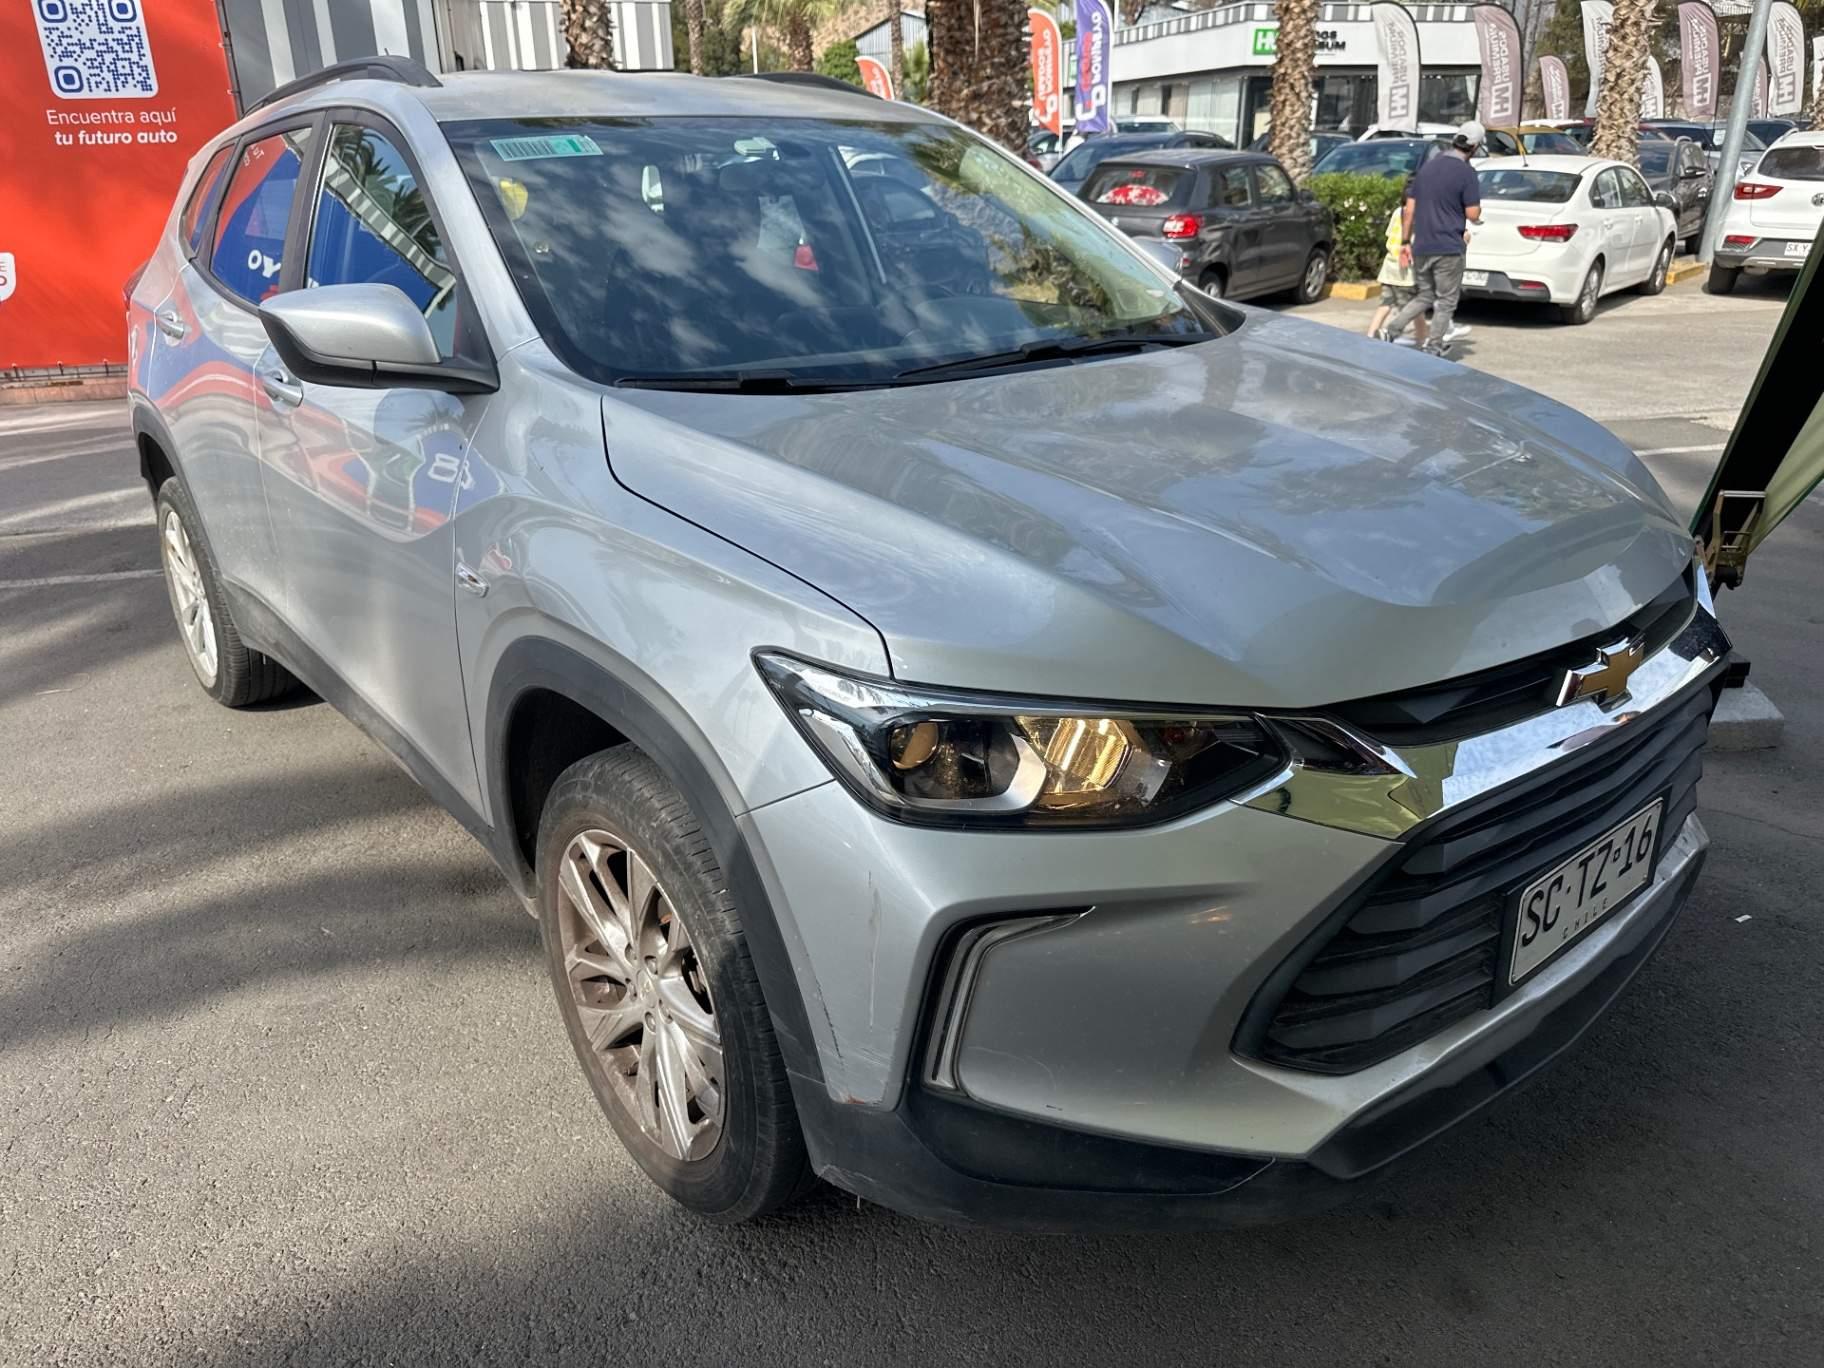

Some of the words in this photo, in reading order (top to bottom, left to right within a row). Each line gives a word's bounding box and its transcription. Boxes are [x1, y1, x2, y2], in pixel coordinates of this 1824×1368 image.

[46, 109, 135, 125] Encuentra
[139, 107, 176, 126] aquí
[55, 131, 73, 145] tu
[78, 130, 132, 145] futuro
[137, 129, 178, 143] auto
[1562, 897, 1610, 940] CHILE
